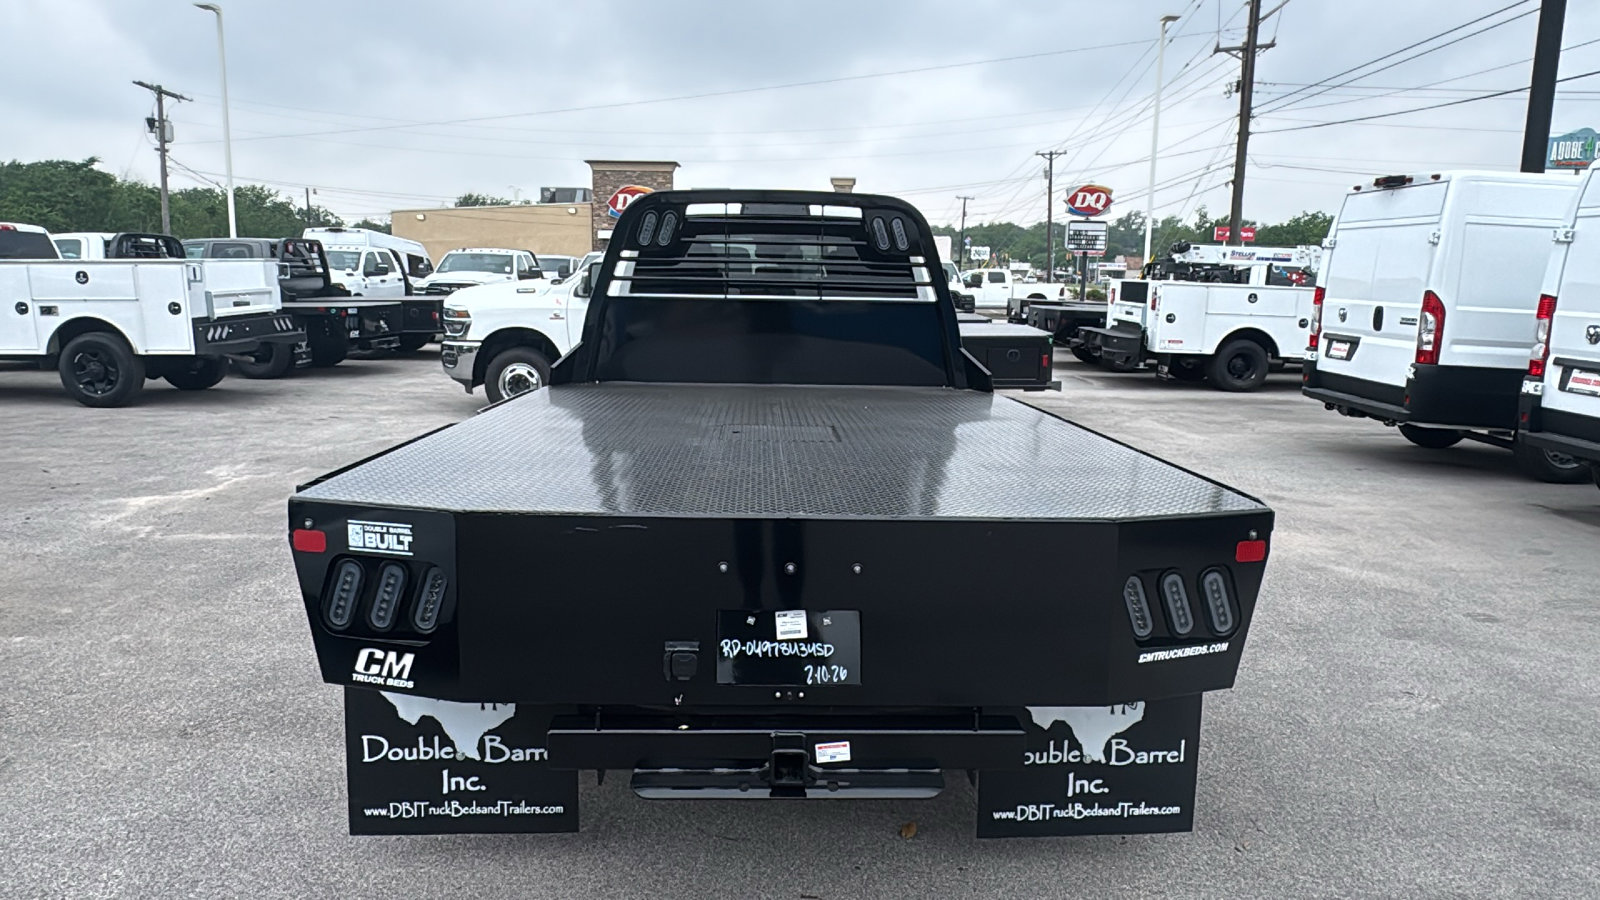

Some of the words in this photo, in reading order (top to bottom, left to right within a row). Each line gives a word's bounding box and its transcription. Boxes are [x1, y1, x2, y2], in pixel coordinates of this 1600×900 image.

[615, 193, 646, 210] D
[1074, 192, 1106, 210] DQ
[364, 532, 413, 551] BUILT
[1138, 642, 1229, 663] CMTRUCKBEDS.COM
[354, 647, 415, 680] CM
[352, 673, 386, 685] TRUCK
[386, 677, 415, 689] BEDS
[361, 735, 455, 763] Double
[483, 735, 549, 763] Barr
[1024, 740, 1081, 765] ouble
[1108, 739, 1186, 766] Barrel
[442, 768, 487, 795] Inc.
[1067, 771, 1110, 797] Inc.
[363, 800, 564, 819] www.DBITruckBedsandTrailers.com
[993, 801, 1181, 821] www.DBITruckBedsandTrailers.com
